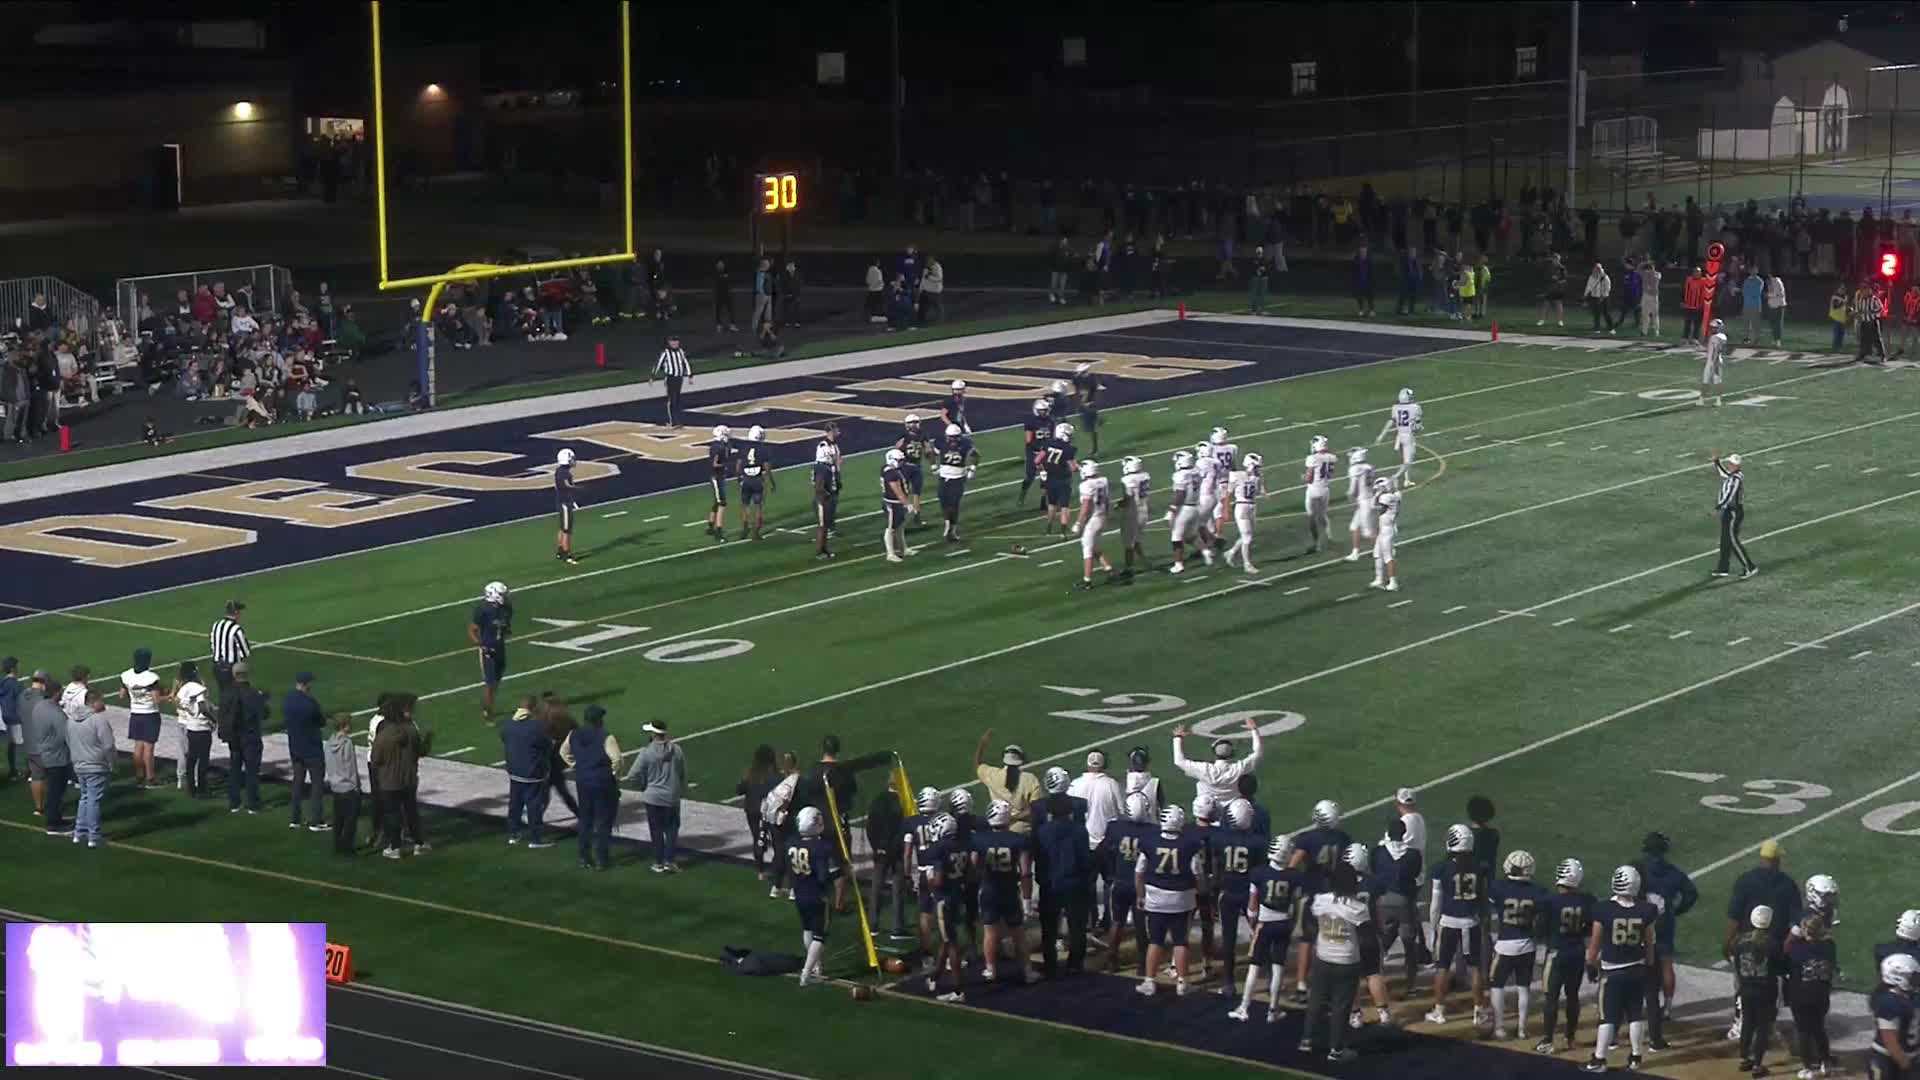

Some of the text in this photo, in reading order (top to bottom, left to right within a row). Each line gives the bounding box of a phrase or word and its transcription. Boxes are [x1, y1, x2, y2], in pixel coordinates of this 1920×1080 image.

[765, 175, 797, 210] 30
[1881, 253, 1897, 276] 2
[1397, 409, 1410, 427] 12
[0, 351, 1258, 569] DECATUR
[747, 448, 757, 465] 4
[1047, 446, 1063, 465] 77
[1216, 451, 1233, 470] 59
[1046, 692, 1307, 740] 20
[788, 846, 812, 876] 38
[1155, 847, 1181, 874] 71
[1223, 845, 1249, 874] 16
[1452, 872, 1478, 901] 13
[1611, 917, 1643, 945] 65
